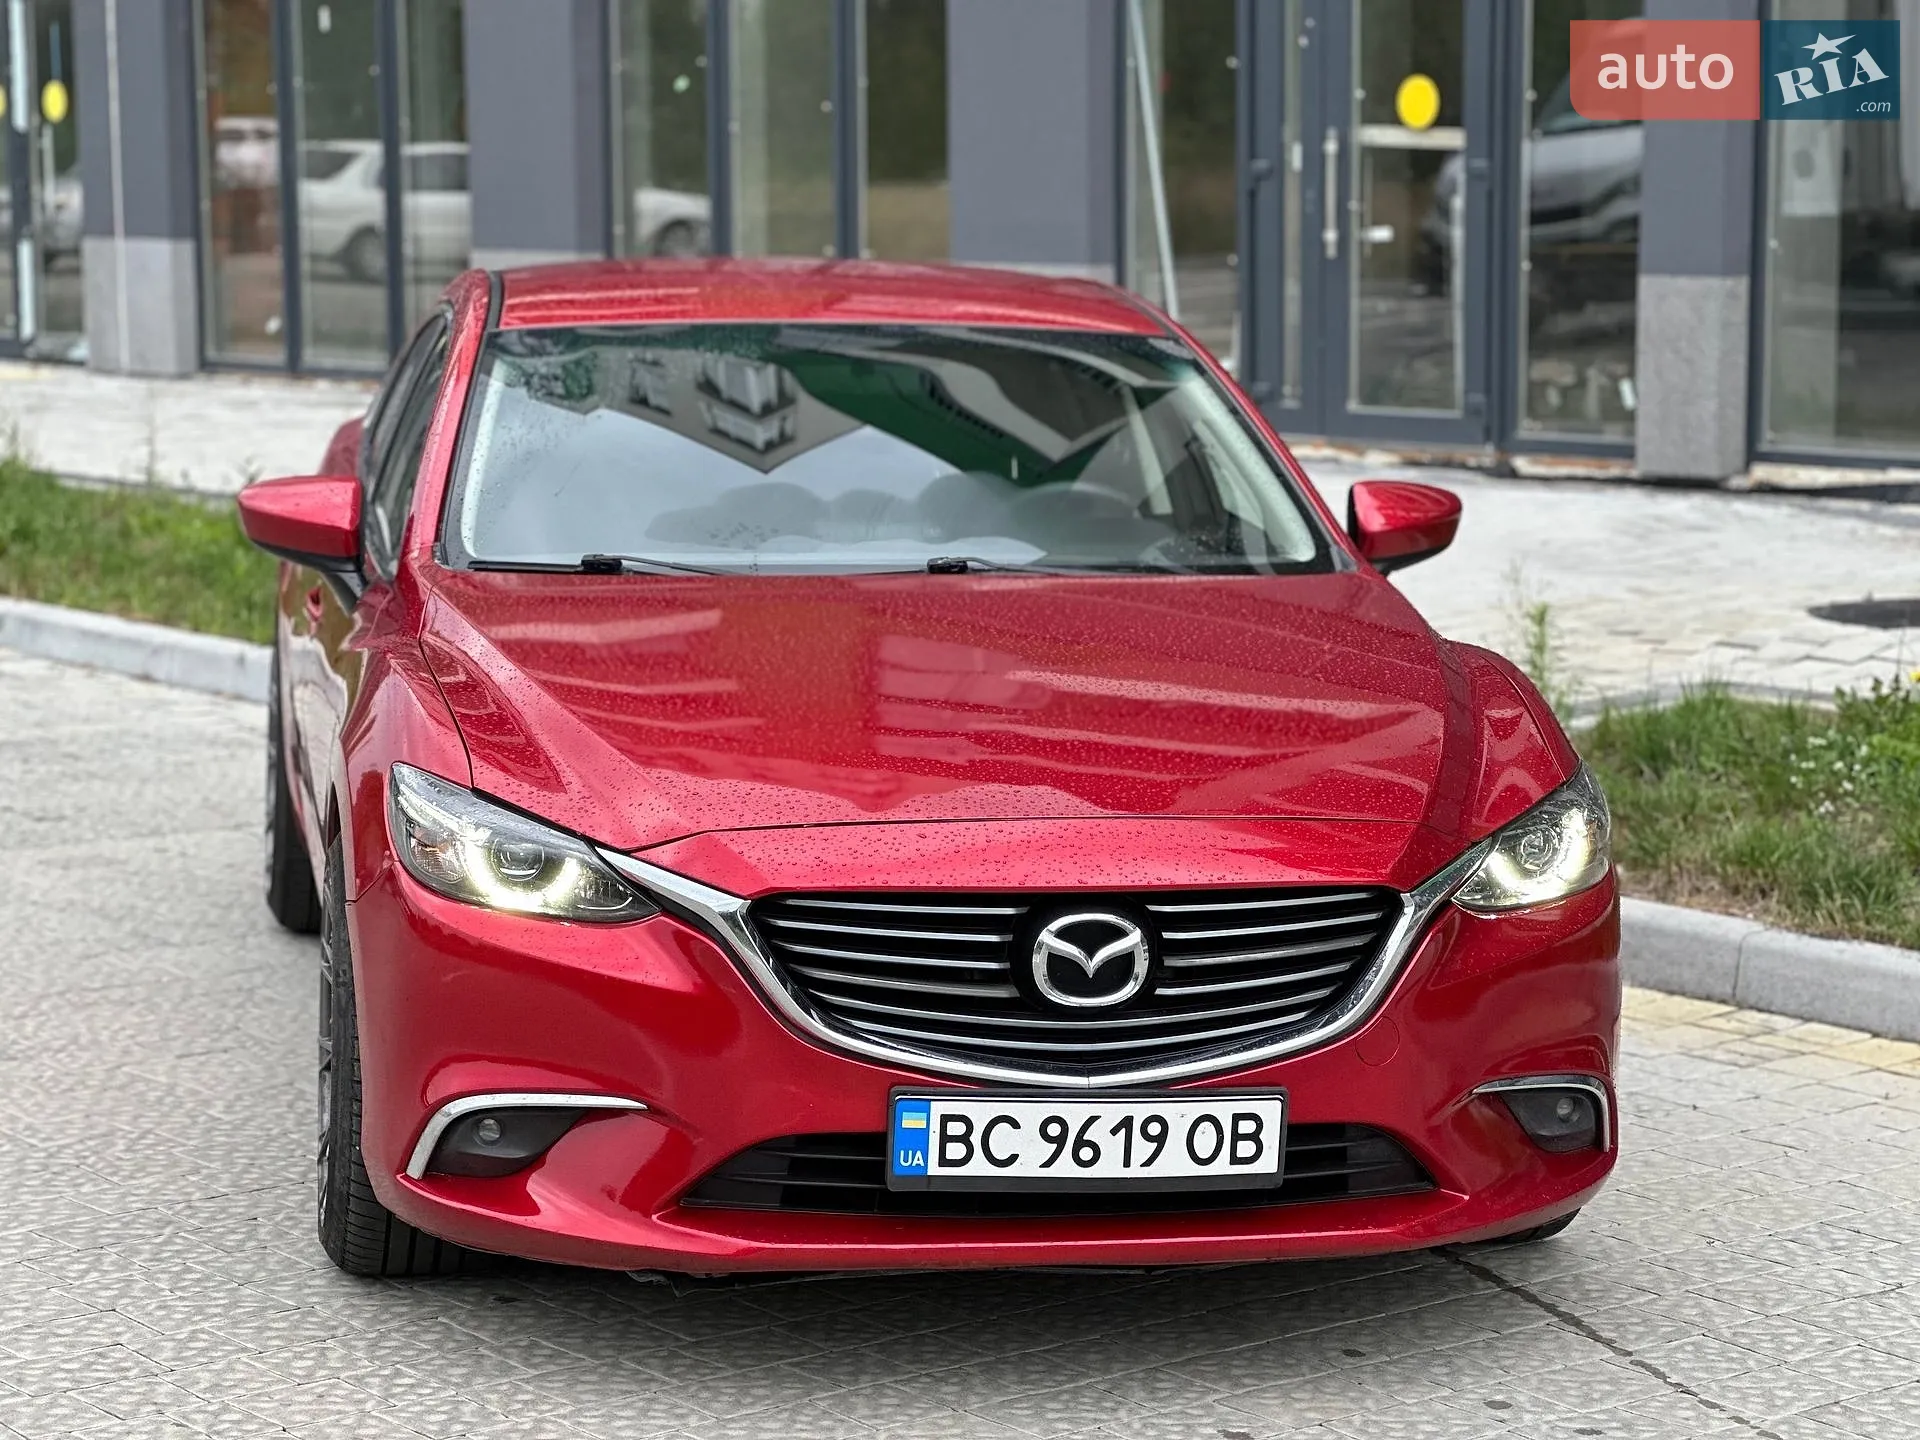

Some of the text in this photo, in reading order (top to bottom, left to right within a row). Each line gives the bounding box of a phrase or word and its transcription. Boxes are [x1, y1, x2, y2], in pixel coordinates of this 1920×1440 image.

[899, 1150, 925, 1168] UA
[938, 1112, 1265, 1169] BC 9619 OB
